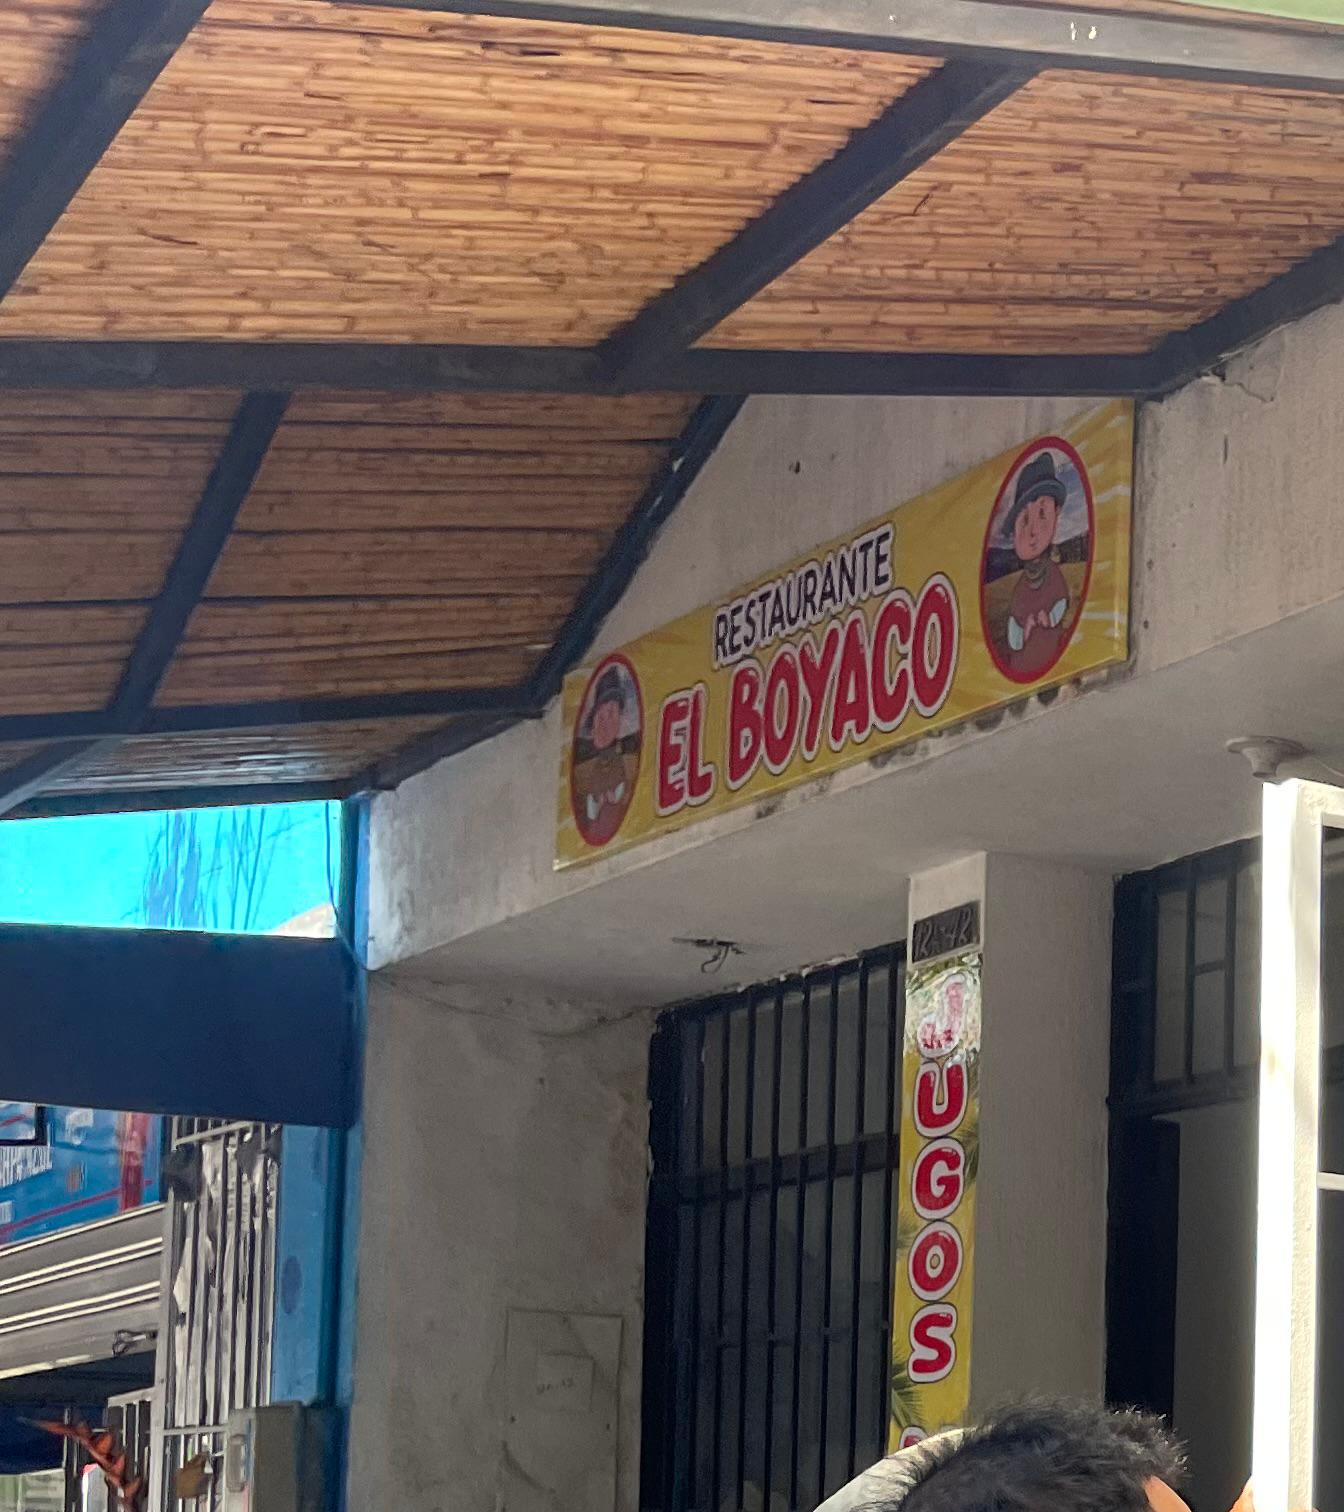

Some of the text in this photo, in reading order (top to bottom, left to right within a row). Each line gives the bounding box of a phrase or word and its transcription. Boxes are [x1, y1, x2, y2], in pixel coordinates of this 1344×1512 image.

[658, 576, 957, 815] EL BOYACO
[714, 528, 893, 662] RESTAURANTE
[908, 974, 968, 1383] JUGOS
